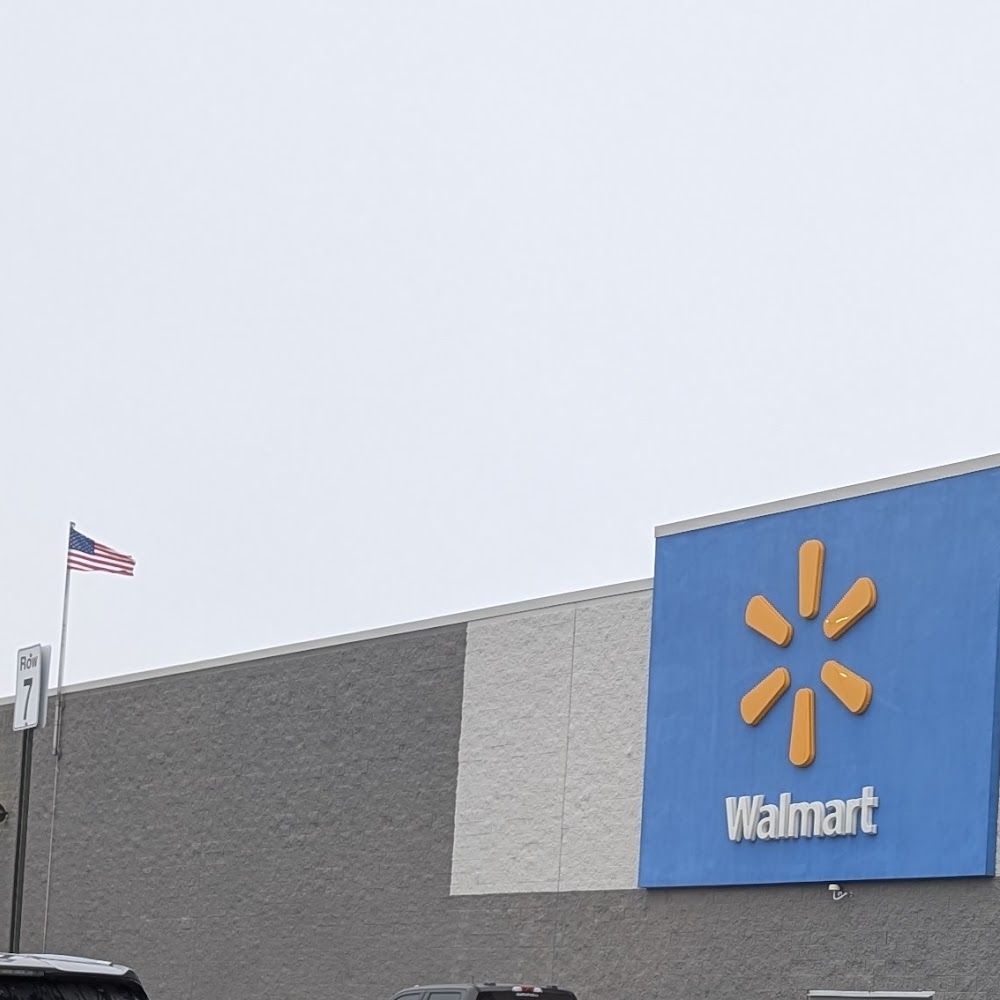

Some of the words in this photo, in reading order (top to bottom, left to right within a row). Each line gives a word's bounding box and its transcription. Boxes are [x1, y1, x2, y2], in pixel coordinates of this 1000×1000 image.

[20, 656, 38, 671] Row
[23, 677, 33, 720] 7
[725, 786, 879, 841] Walmart
